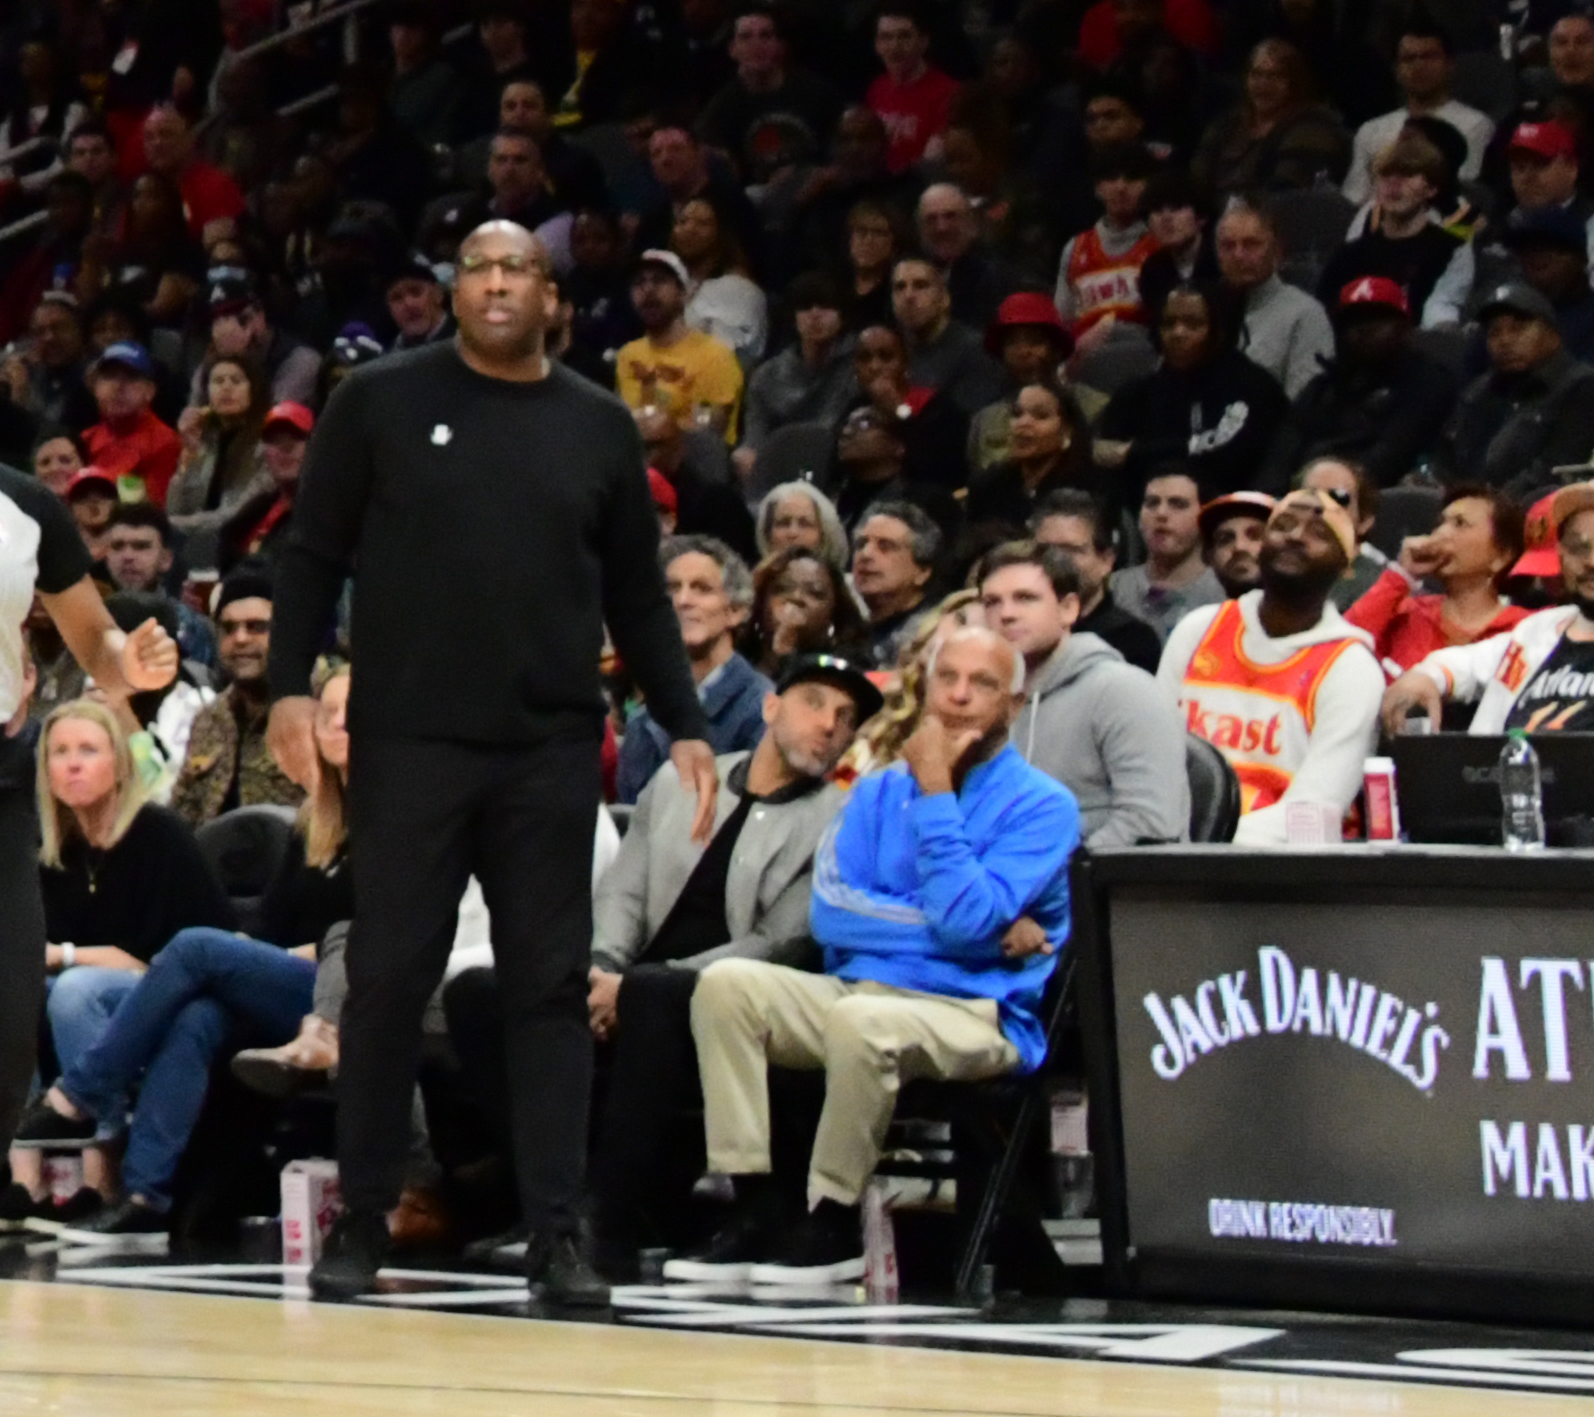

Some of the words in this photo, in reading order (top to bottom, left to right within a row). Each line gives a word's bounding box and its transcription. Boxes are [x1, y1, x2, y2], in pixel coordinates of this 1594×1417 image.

[1178, 698, 1283, 756] kast
[1144, 970, 1261, 1080] JACK
[1479, 1119, 1594, 1202] MAK
[1209, 1198, 1268, 1239] DRINK
